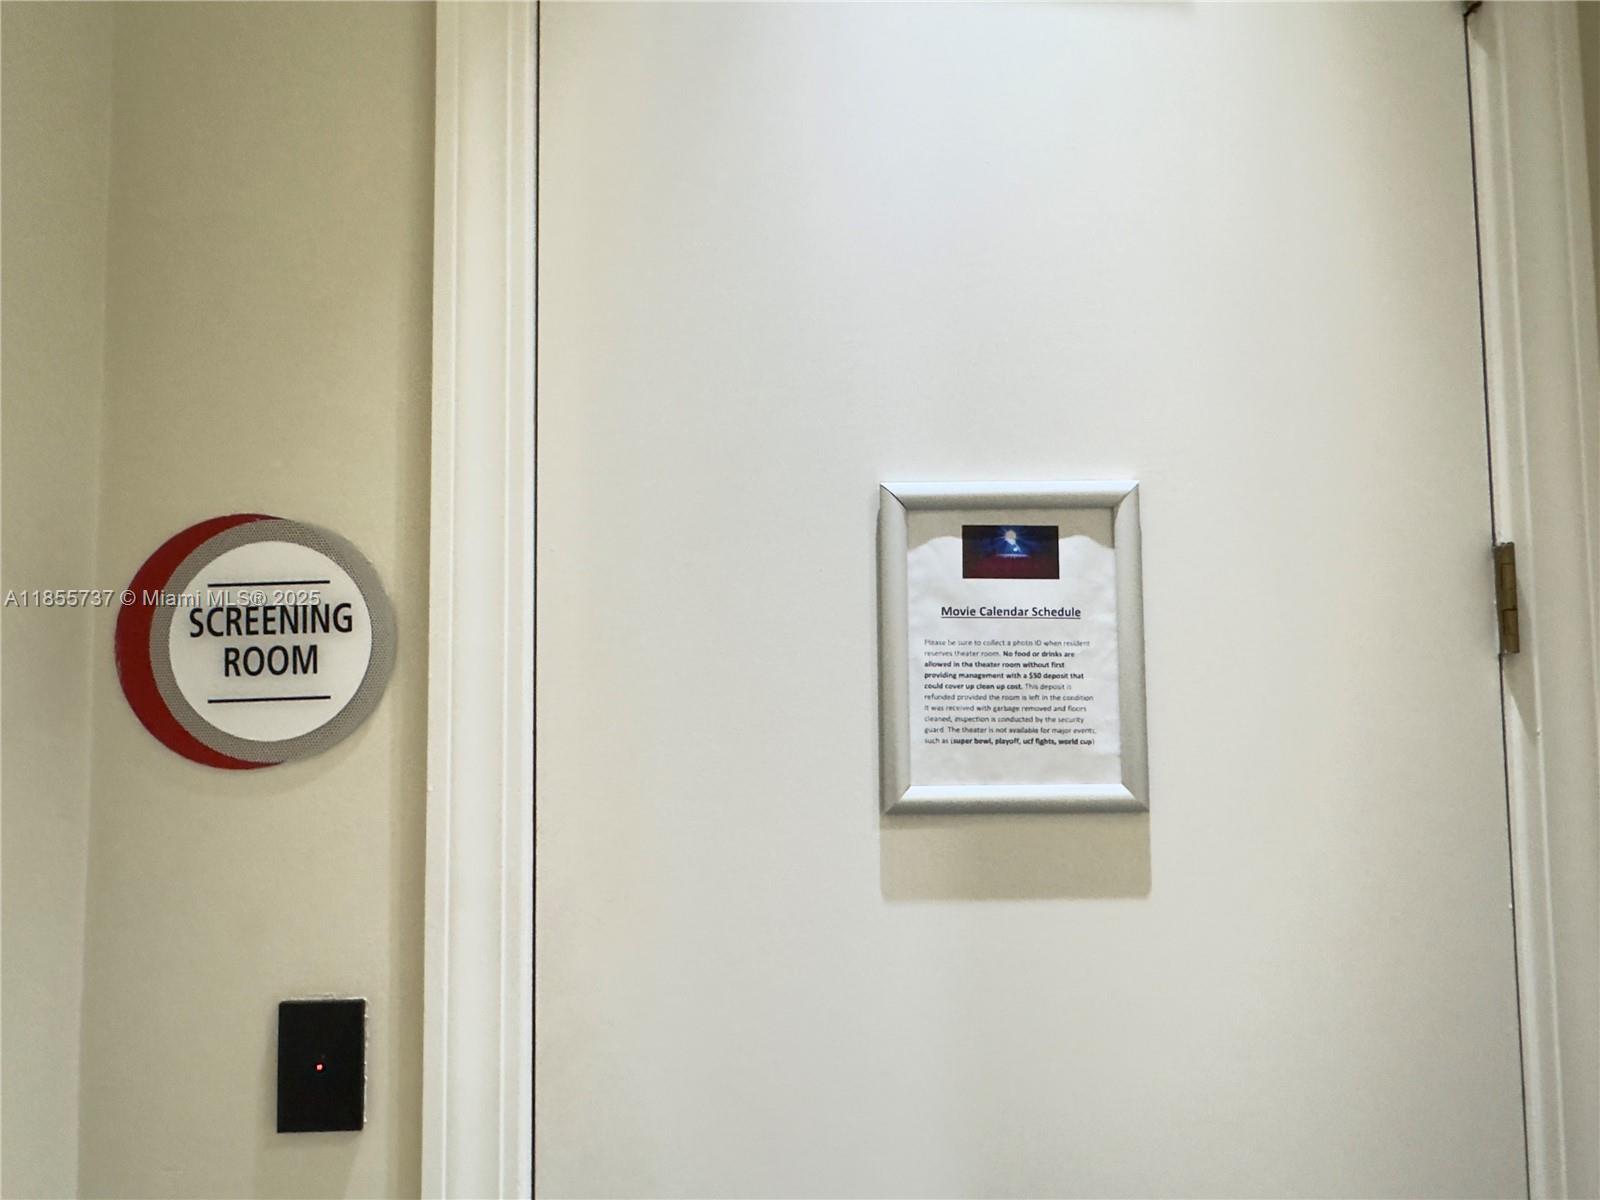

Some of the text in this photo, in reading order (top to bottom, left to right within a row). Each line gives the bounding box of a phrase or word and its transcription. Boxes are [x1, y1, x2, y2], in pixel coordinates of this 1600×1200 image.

[941, 606, 1081, 617] Movie Calendar Schedule
[189, 602, 353, 638] SCREENING
[924, 638, 946, 646] Please
[1014, 649, 1031, 657] food
[1041, 649, 1063, 657] drinks
[224, 644, 318, 677] ROOM
[924, 660, 952, 668] allowed
[961, 660, 974, 668] the
[974, 660, 1001, 668] theater
[1022, 660, 1050, 668] without
[1050, 660, 1065, 668] first
[924, 672, 957, 680] providing
[958, 672, 1005, 680] management
[1005, 671, 1022, 679] with
[1042, 672, 1069, 680] deposit
[924, 681, 944, 689] could
[976, 682, 996, 690] clean
[1025, 682, 1039, 690] This
[1040, 683, 1065, 691] deposit
[924, 692, 956, 700] refunded
[957, 693, 988, 701] provided
[988, 693, 1001, 701] the
[1028, 693, 1040, 701] left
[1049, 693, 1062, 701] the
[992, 705, 1020, 713] garbage
[1053, 704, 1067, 712] and
[1067, 704, 1087, 712] floors
[997, 715, 1034, 723] conducted
[1044, 715, 1057, 723] the
[1057, 716, 1084, 724] security
[947, 725, 961, 733] The
[1009, 726, 1039, 734] available
[1039, 726, 1050, 734] for
[1051, 727, 1071, 735] major
[1058, 737, 1079, 745] world
